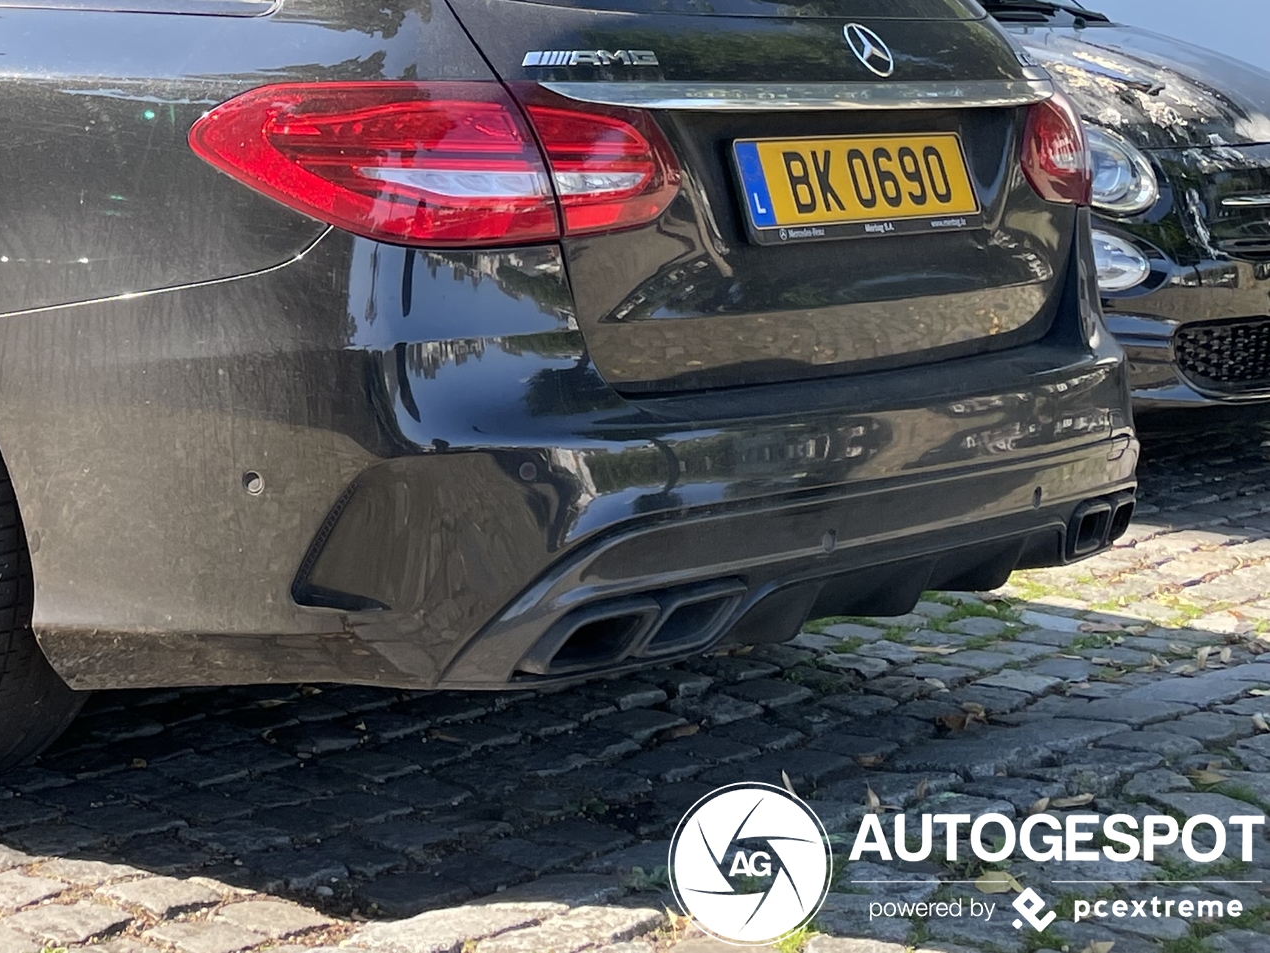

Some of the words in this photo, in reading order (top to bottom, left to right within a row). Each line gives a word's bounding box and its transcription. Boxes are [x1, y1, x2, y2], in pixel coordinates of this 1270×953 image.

[569, 50, 659, 66] AMG
[782, 150, 846, 214] BK
[847, 145, 952, 208] 0690
[753, 193, 767, 214] L
